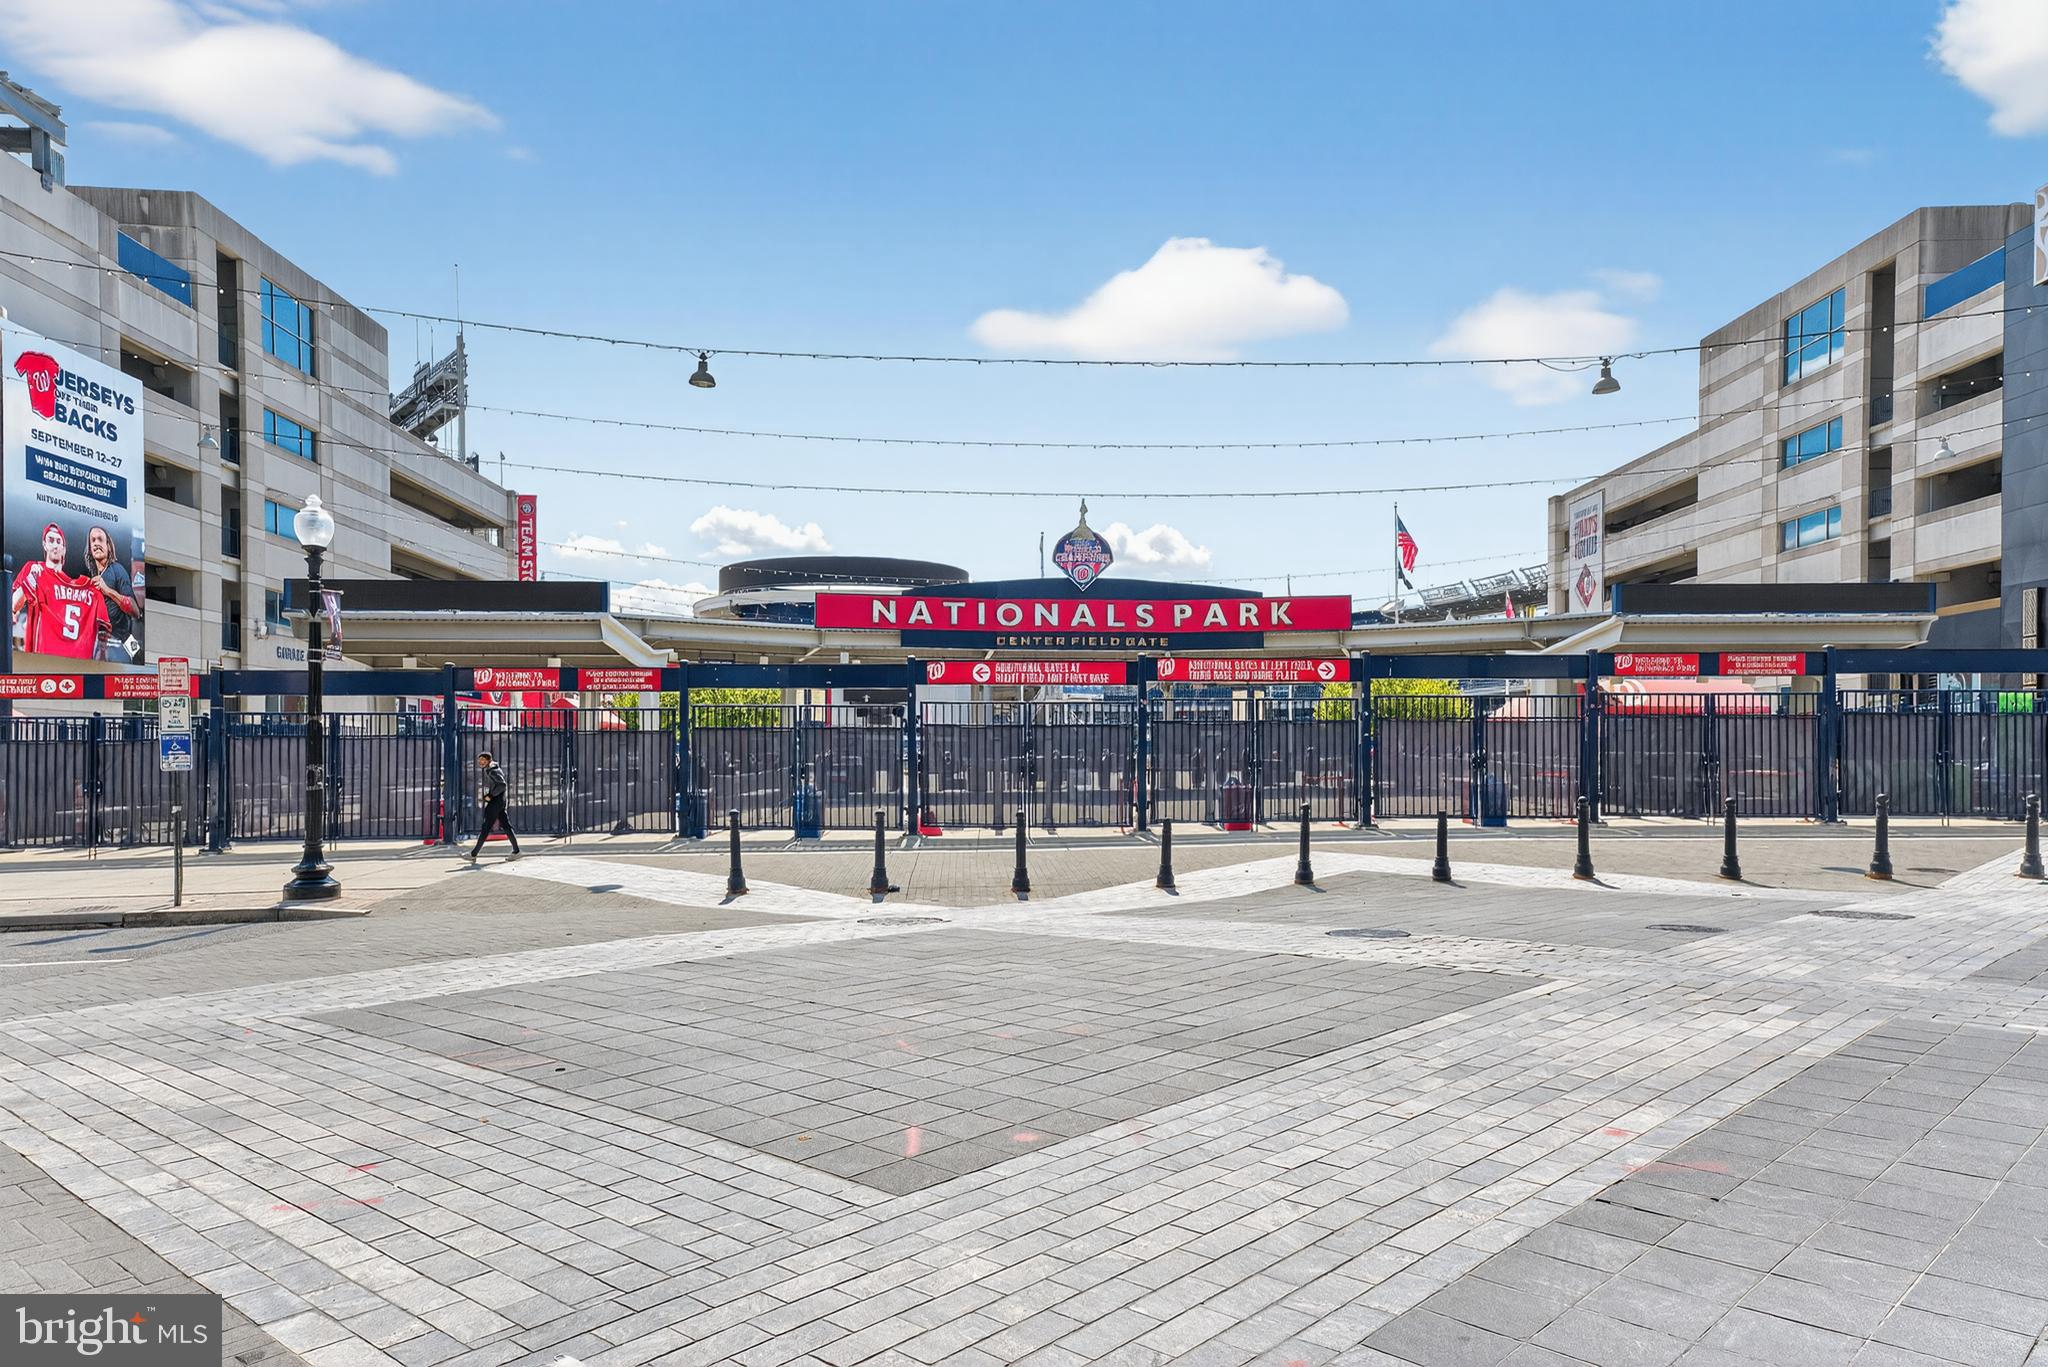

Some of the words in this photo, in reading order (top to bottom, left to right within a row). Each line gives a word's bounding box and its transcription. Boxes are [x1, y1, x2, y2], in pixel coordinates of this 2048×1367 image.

[54, 369, 135, 415] JERSEYS
[55, 402, 118, 441] BACKS
[31, 428, 94, 459] SEPTEMBER
[521, 518, 533, 556] TEAM
[62, 604, 80, 640] 5
[871, 599, 1155, 628] NATIONALS
[1173, 602, 1293, 628] PARK
[1071, 636, 1120, 646] FIELD
